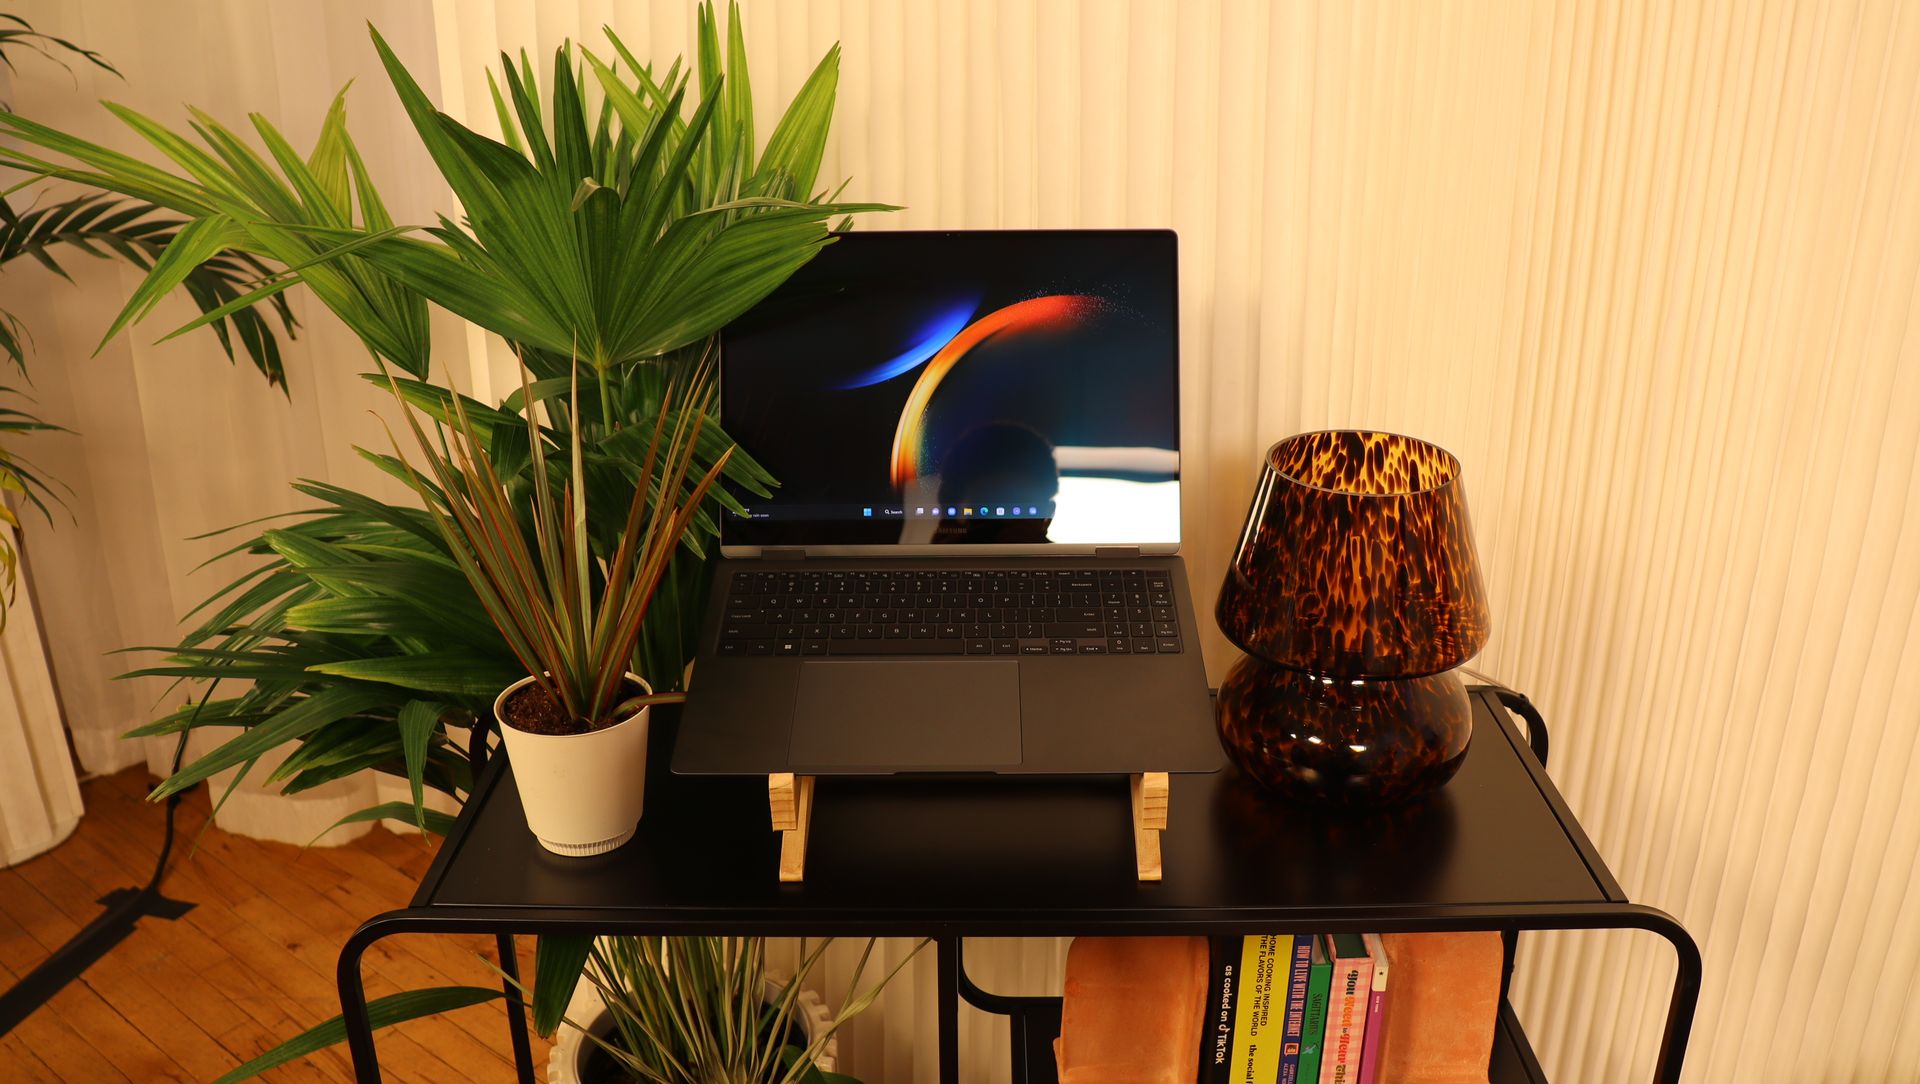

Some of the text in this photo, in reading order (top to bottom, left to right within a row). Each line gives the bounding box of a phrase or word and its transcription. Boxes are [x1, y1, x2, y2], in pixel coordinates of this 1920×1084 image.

[1250, 936, 1268, 1037] THE FLAVORS OF THE WORLD
[1260, 934, 1276, 1026] HOME COOKING INSPIRED
[1287, 946, 1310, 1037] HOW TO LIVE WITH THE INTERNET
[1346, 970, 1359, 995] You
[1215, 965, 1232, 1064] as cooked on TikTok
[1309, 992, 1322, 1036] SAGITTARIUS
[1342, 996, 1355, 1027] Need
[1249, 1044, 1257, 1057] the
[1338, 1033, 1350, 1064] Hear
[1246, 1058, 1254, 1080] social
